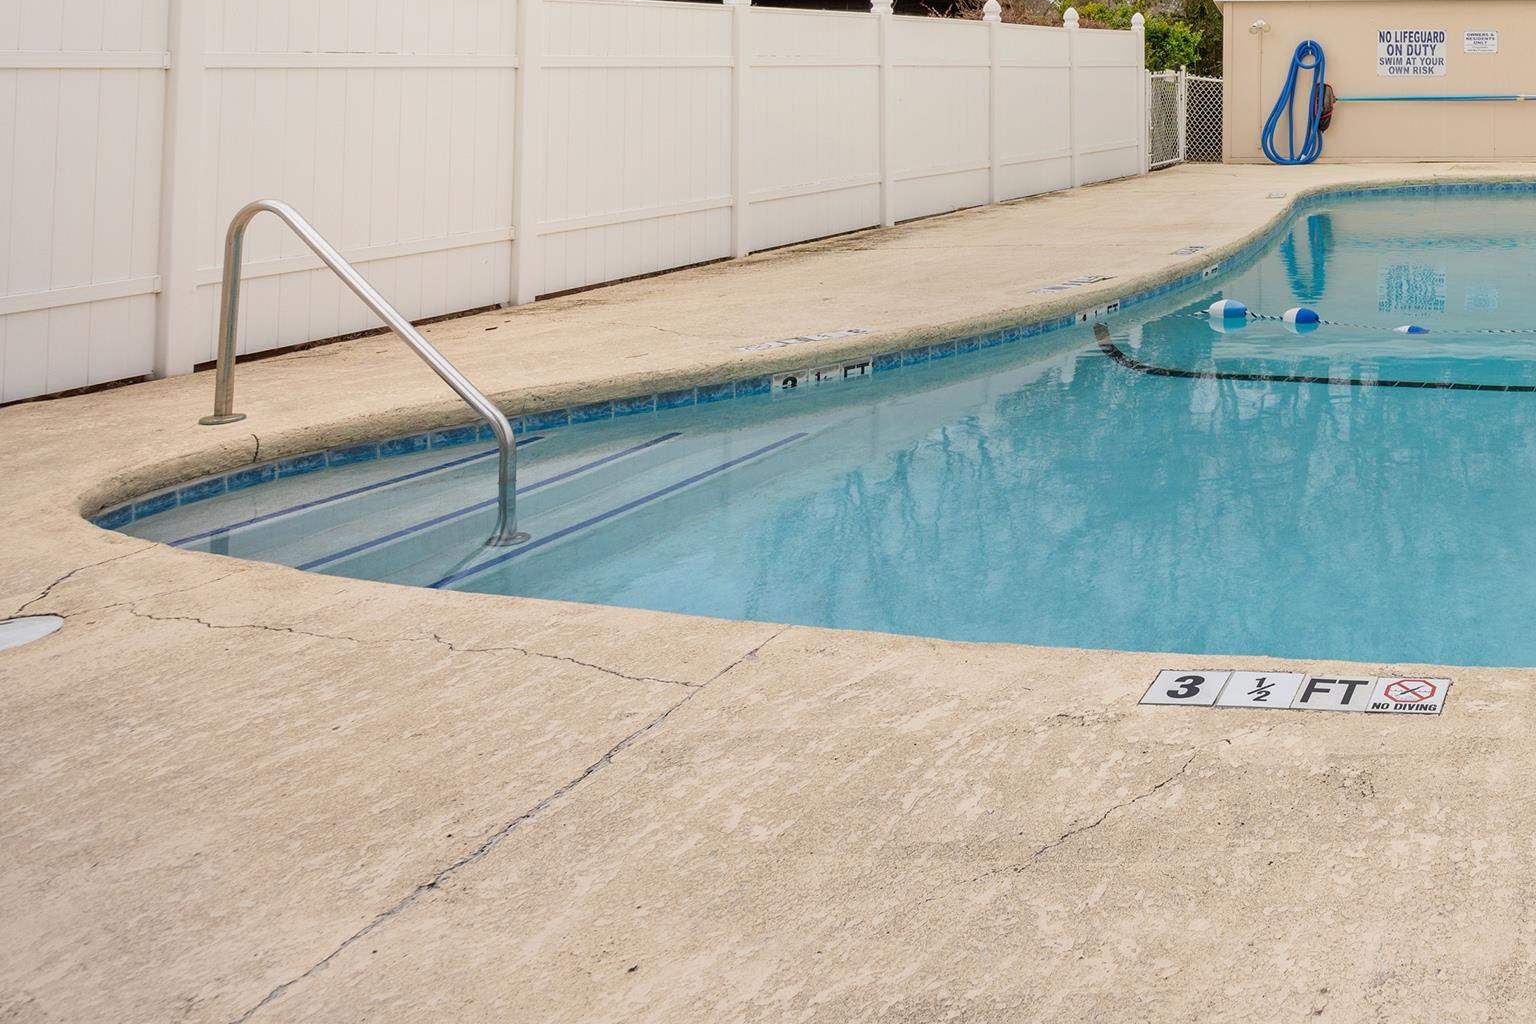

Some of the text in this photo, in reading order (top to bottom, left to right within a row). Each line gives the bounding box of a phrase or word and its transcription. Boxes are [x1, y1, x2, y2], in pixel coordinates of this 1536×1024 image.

[1379, 31, 1445, 43] NO LIFEGUARD
[1387, 44, 1436, 56] ON DUTY
[1380, 57, 1444, 66] SWIM AT YOUR
[1389, 66, 1434, 75] OWN RISK
[1166, 675, 1205, 699] 3
[1299, 678, 1370, 705] FT
[1371, 702, 1438, 711] NO DIVING
